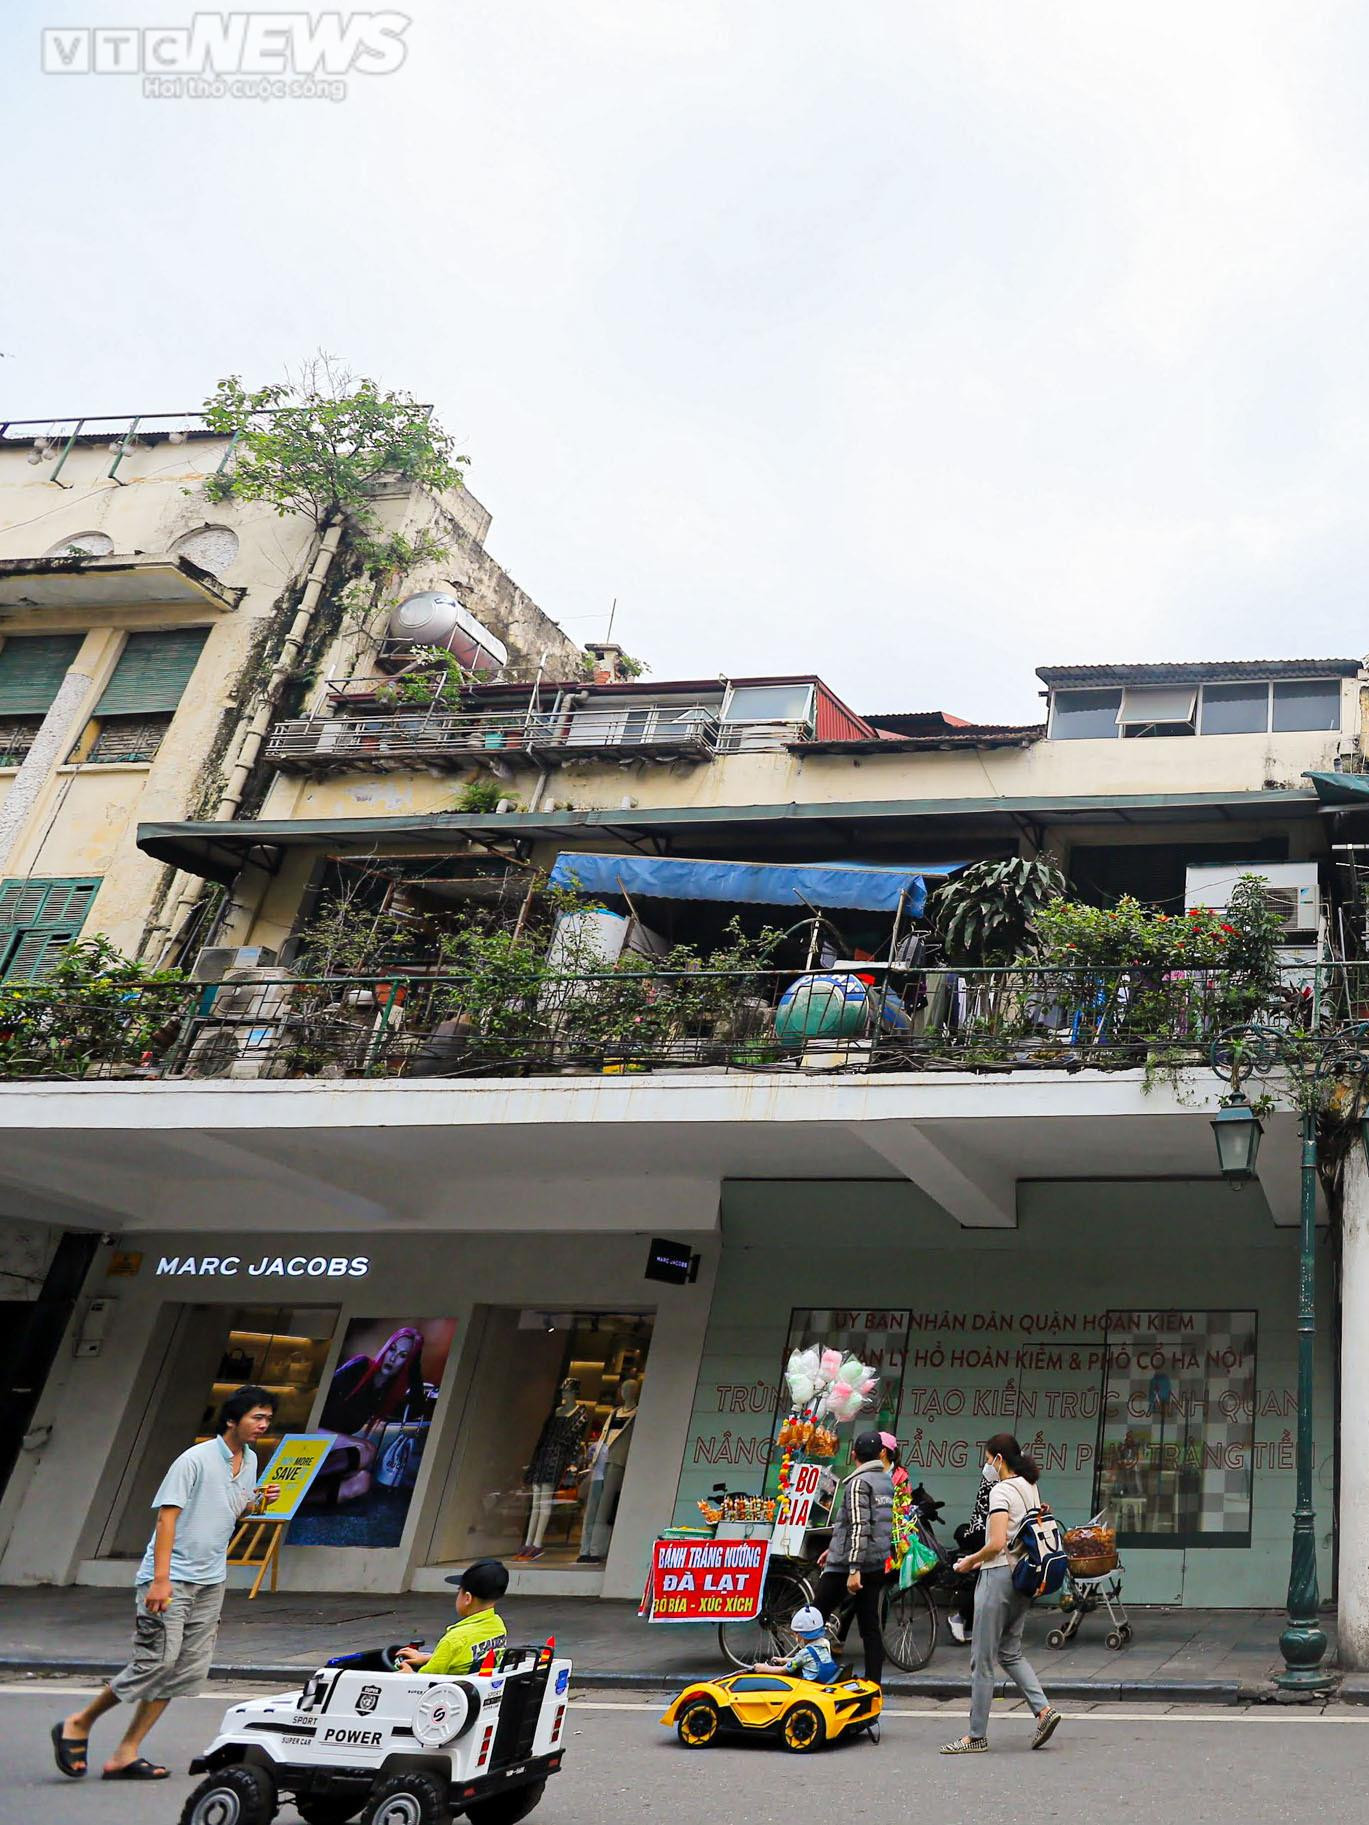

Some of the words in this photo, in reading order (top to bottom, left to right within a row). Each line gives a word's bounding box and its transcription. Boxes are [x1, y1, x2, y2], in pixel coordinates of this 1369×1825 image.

[156, 1257, 241, 1276] MARC
[249, 1257, 369, 1276] JACOBS
[864, 1312, 904, 1329] BAN
[951, 1345, 1009, 1368] HOÀN
[1069, 1352, 1081, 1370] &
[717, 1380, 789, 1412] TRÙN
[912, 1388, 965, 1423] TẠO
[973, 1378, 1039, 1418] KIẾN
[272, 1467, 301, 1481] SAVE
[658, 1543, 688, 1569] BÁNH
[688, 1542, 723, 1569] TRÁNG
[724, 1542, 761, 1568] NƯỚNG
[663, 1571, 695, 1591] ĐÀ
[703, 1574, 750, 1594] LẠT
[668, 1595, 687, 1612] BÍA
[698, 1595, 722, 1613] XÚC
[724, 1595, 753, 1612] XÍCH
[292, 1715, 318, 1726] SPORT
[324, 1728, 383, 1745] POWER
